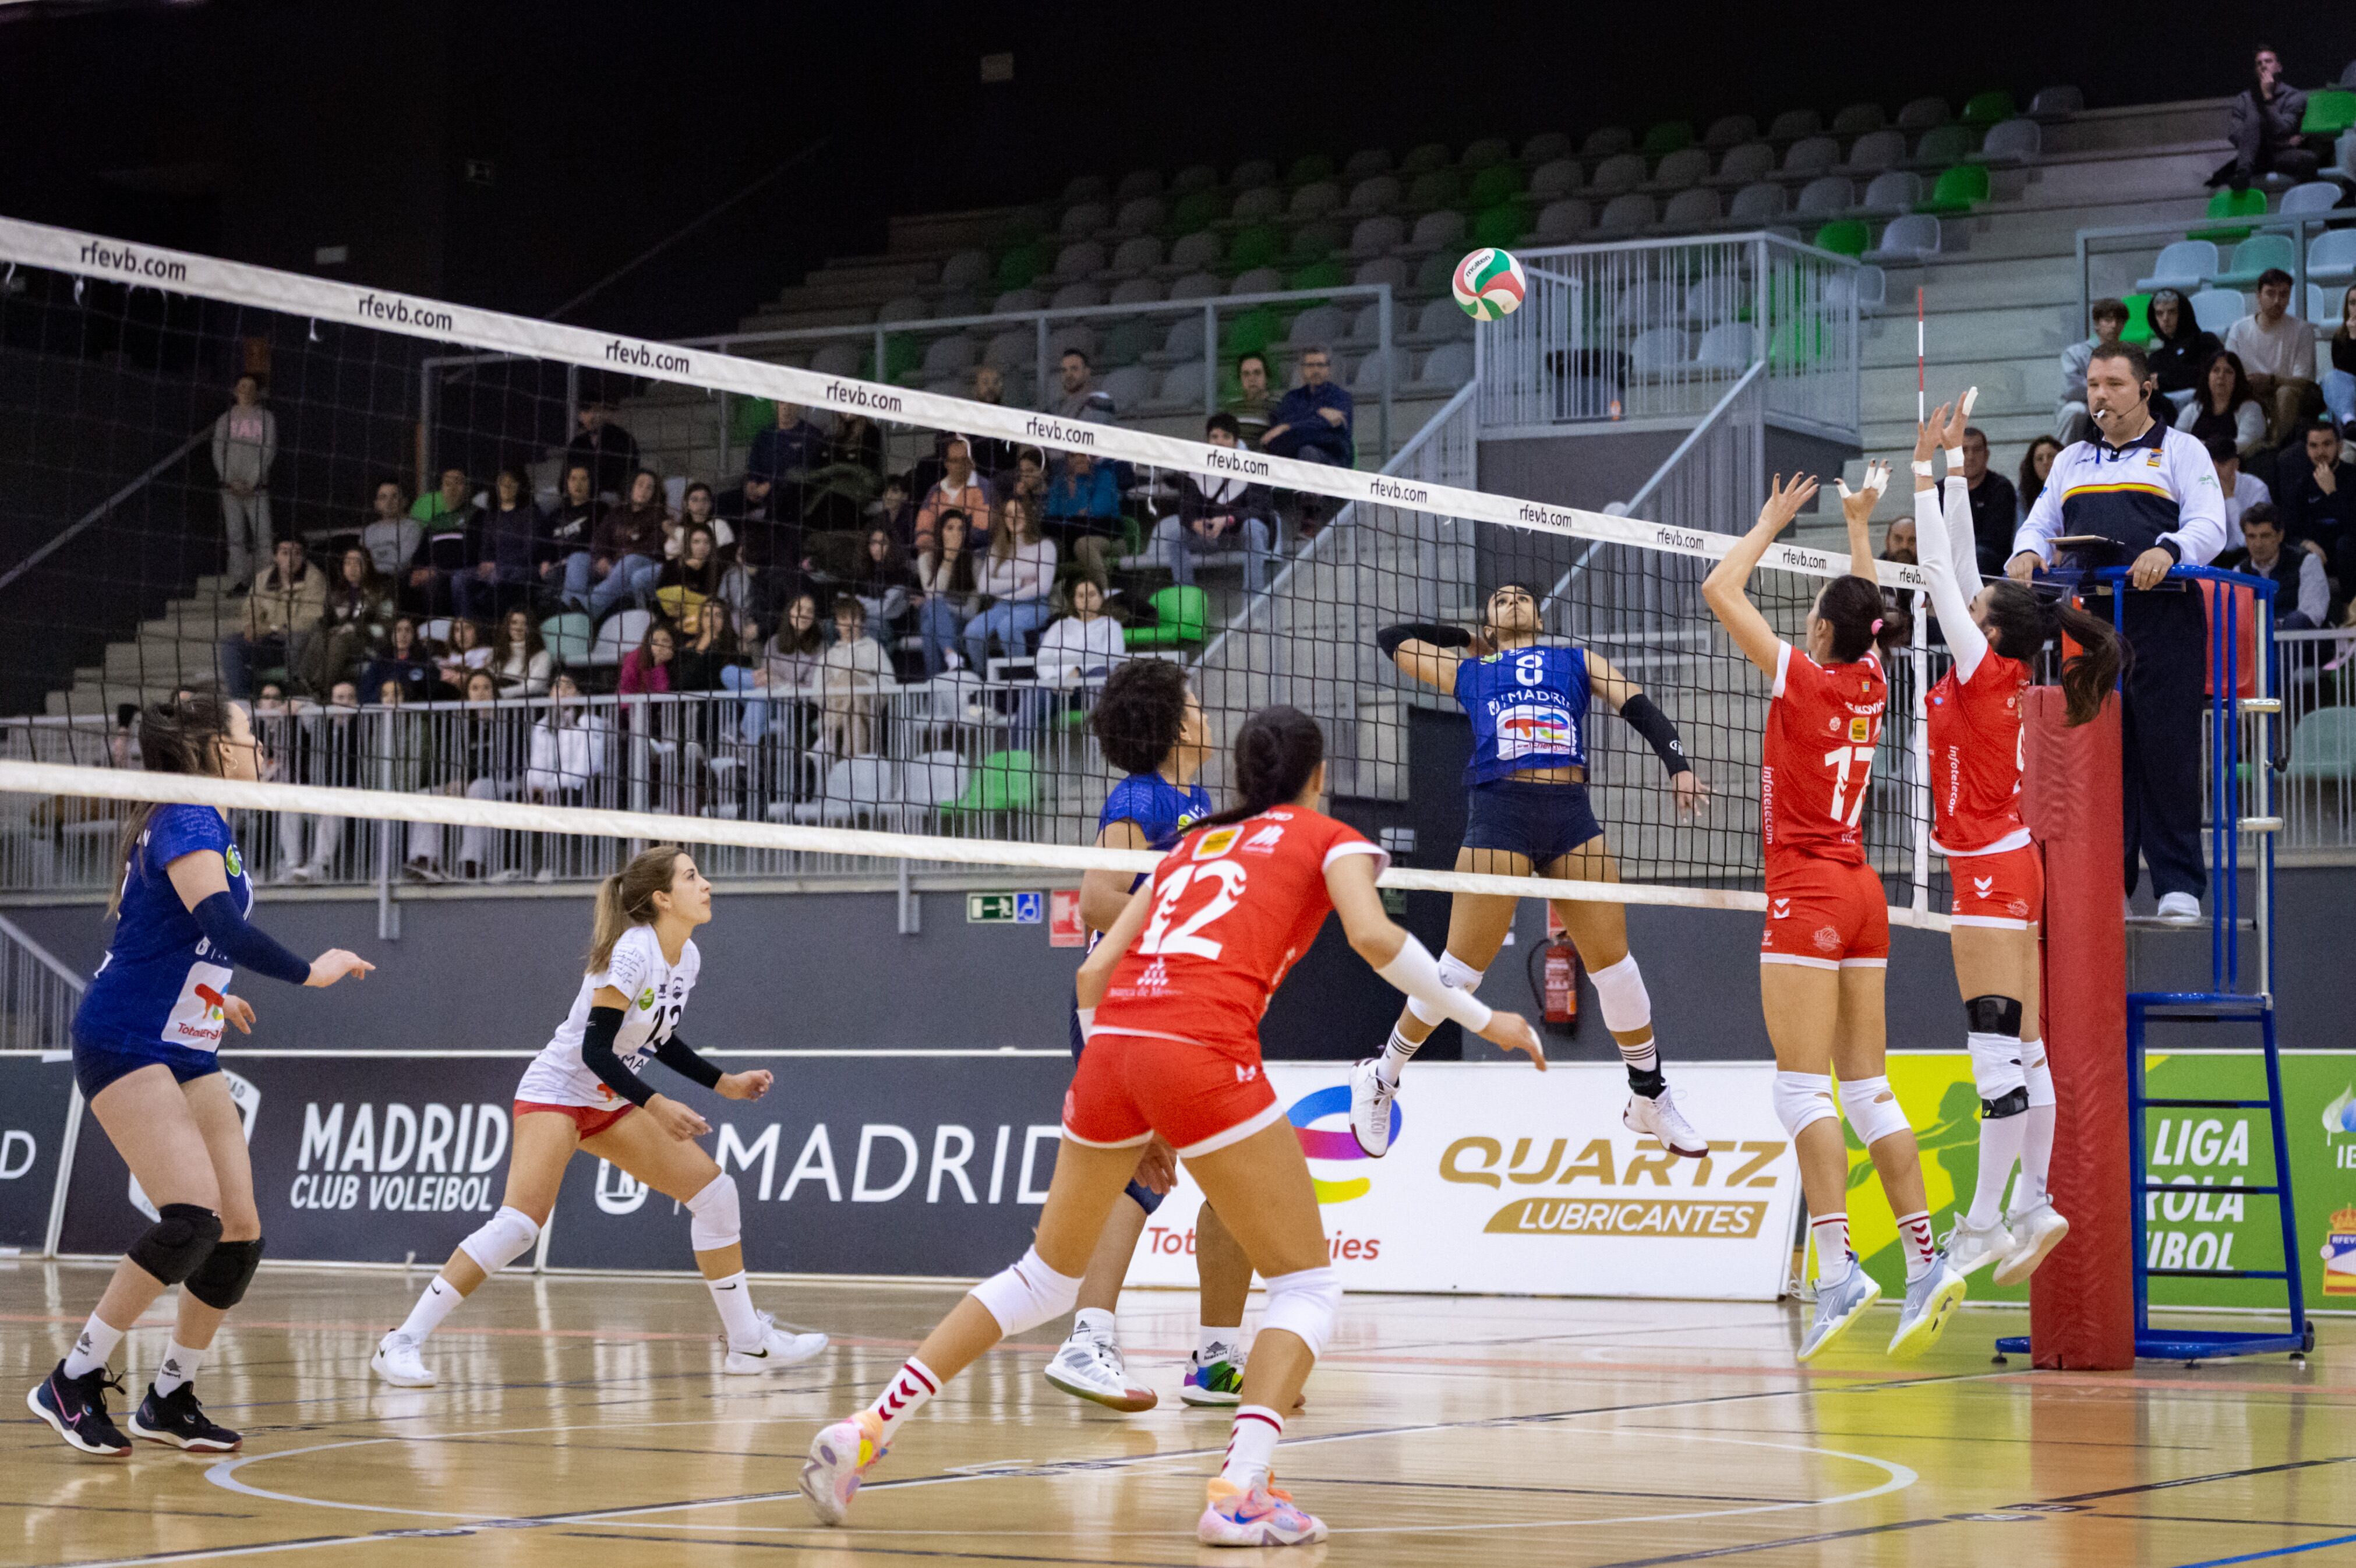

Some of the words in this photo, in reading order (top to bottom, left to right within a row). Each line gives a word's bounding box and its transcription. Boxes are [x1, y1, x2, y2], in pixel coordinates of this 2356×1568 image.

[80, 242, 186, 282] rfevb.com
[1465, 255, 1491, 277] molten
[358, 294, 453, 331] rfevb.com
[605, 341, 690, 374] rfevb.com
[826, 381, 902, 413] rfevb.com
[1027, 417, 1094, 446] rfevb.com
[1207, 449, 1269, 476] rfevb.com
[1370, 479, 1428, 504] rfevb.com
[1520, 507, 1572, 528] rfevb.com
[1656, 529, 1704, 550] rfevb.com
[1782, 549, 1827, 570] rfevb.com
[1899, 567, 1926, 585] rfevb.
[1825, 746, 1875, 827] 17
[1947, 745, 1961, 817] infotelecom
[1762, 766, 1774, 845] infotelecom
[1138, 860, 1247, 960] 12
[298, 1103, 508, 1174] MADRID
[2152, 1119, 2248, 1166] LIGA
[1439, 1136, 1788, 1191] QUARTZ
[291, 1174, 359, 1211] CLUB
[370, 1175, 493, 1212] VOLEIBOL
[1518, 1202, 1755, 1234] LUBRICANTES
